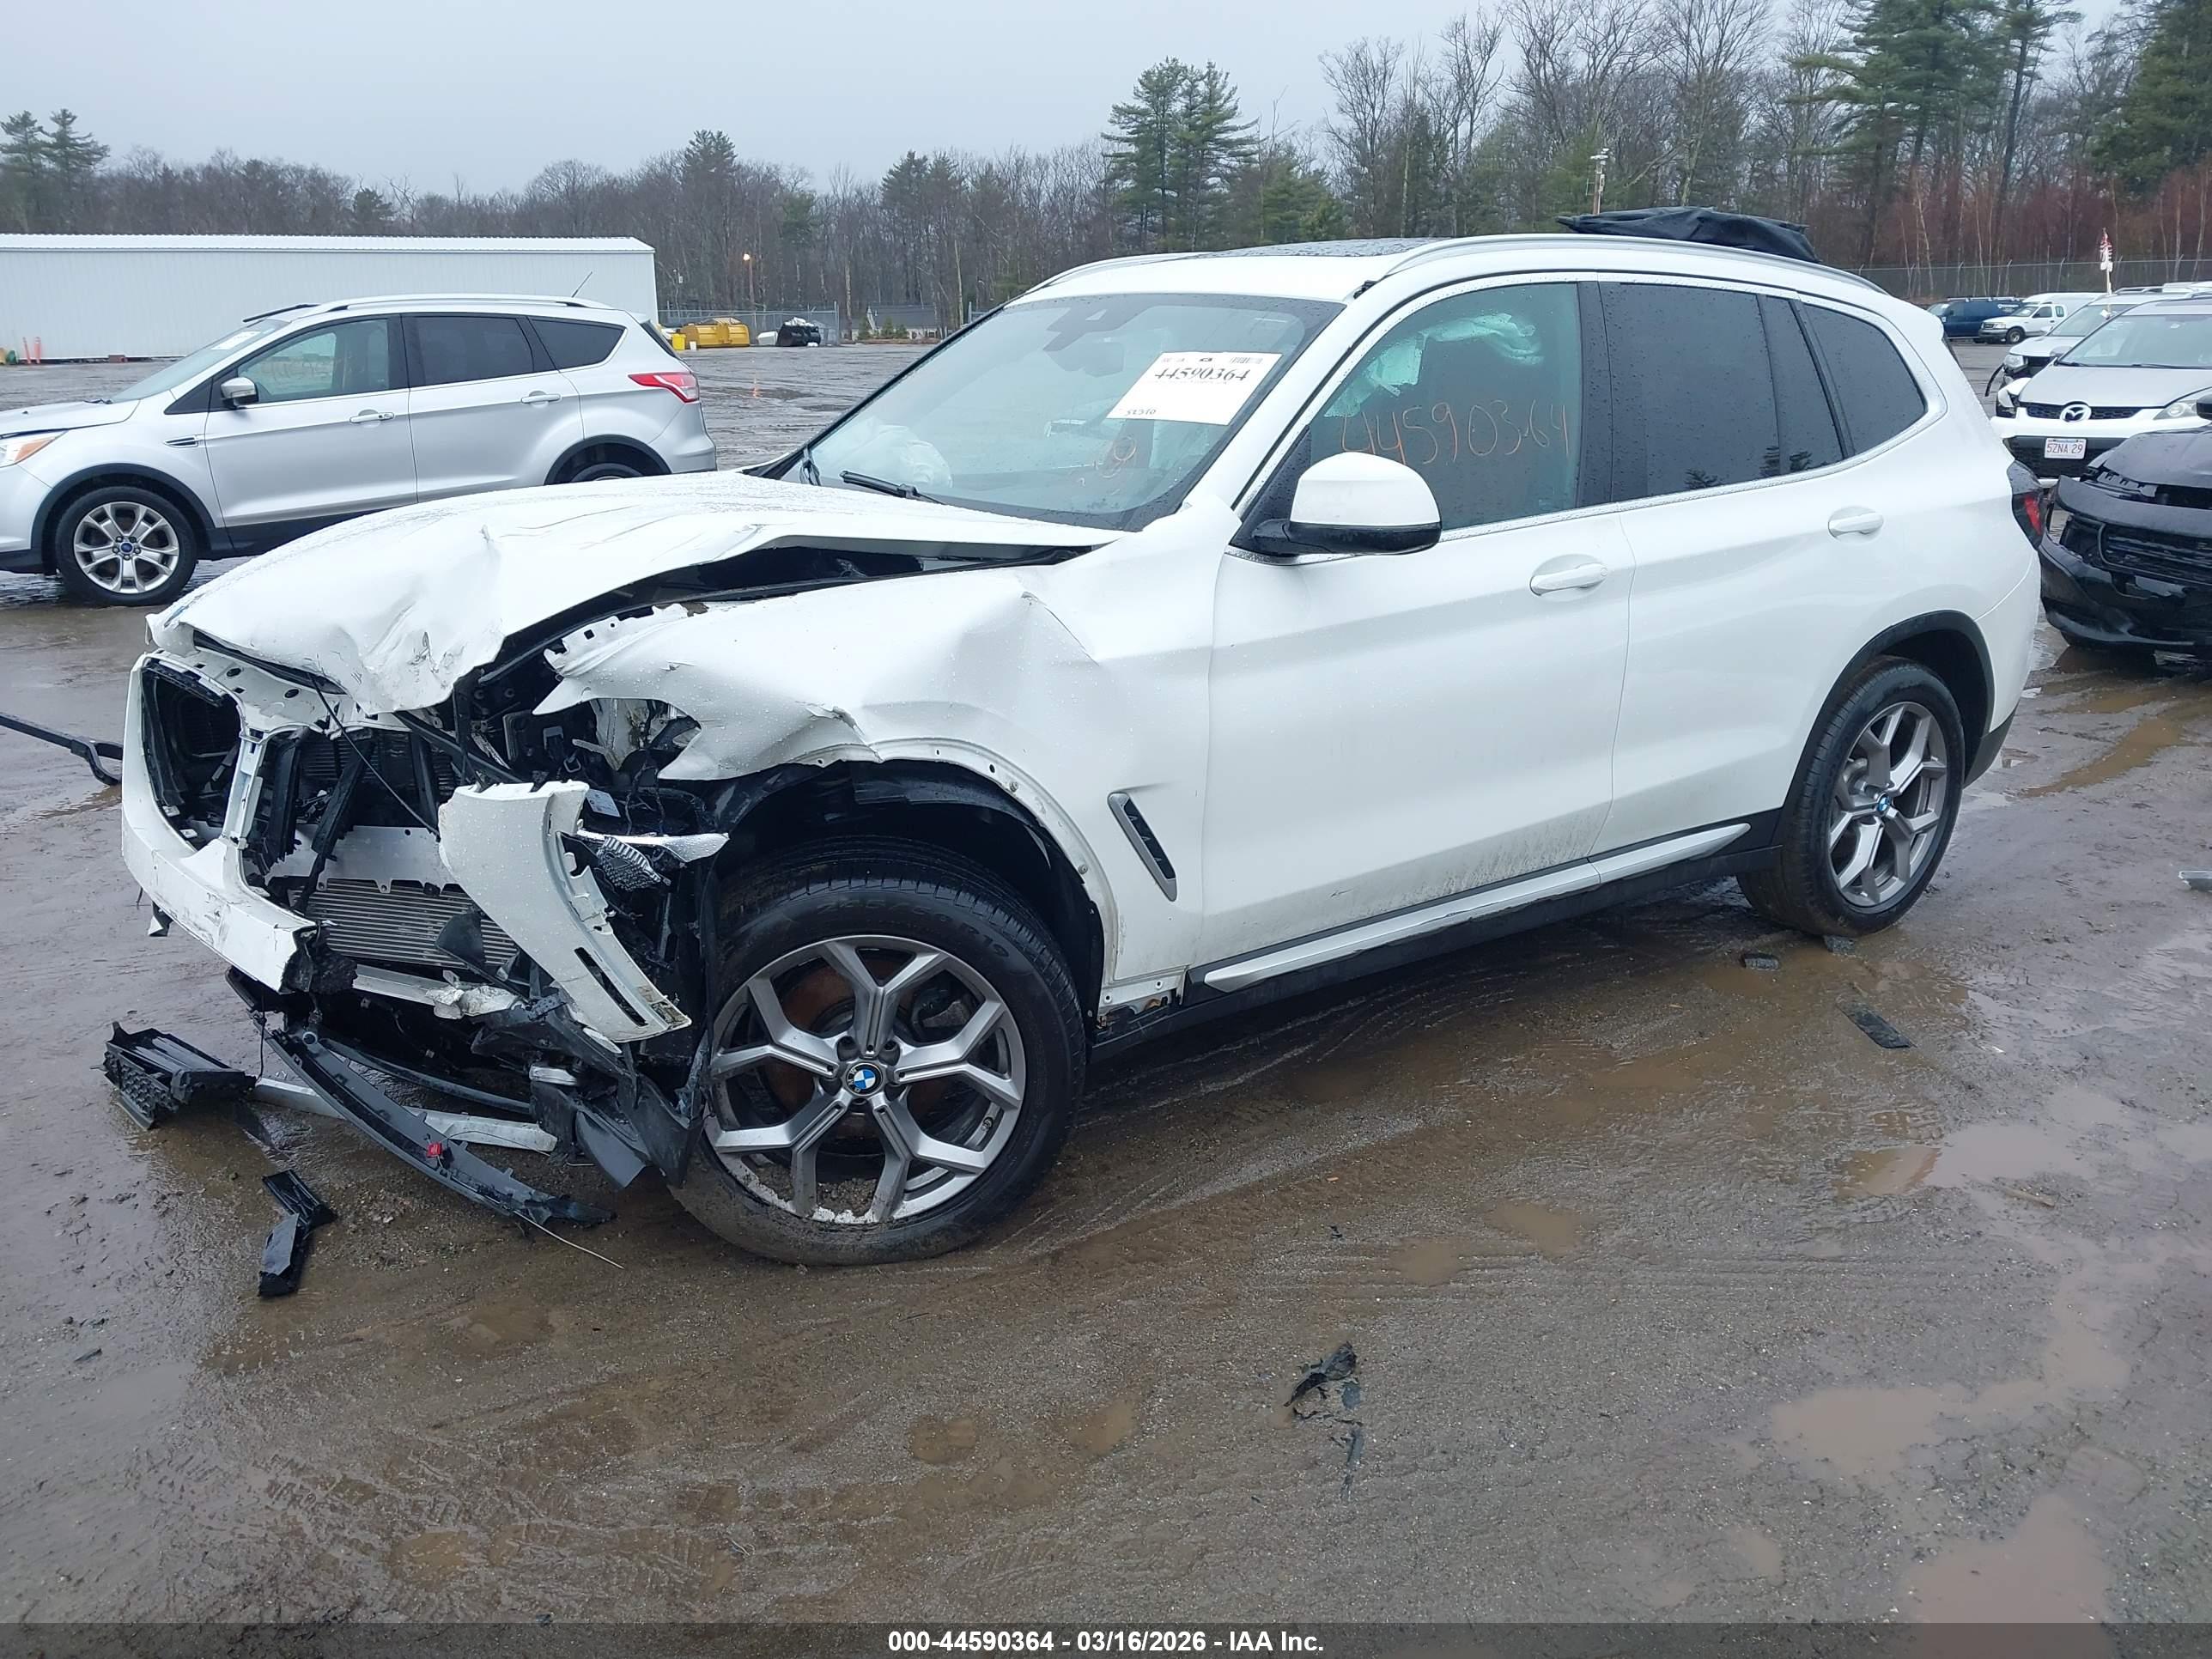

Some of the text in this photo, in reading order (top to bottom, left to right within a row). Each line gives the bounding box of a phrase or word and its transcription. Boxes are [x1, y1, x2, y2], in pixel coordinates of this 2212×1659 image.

[1155, 367, 1251, 381] 44590364
[1341, 399, 1570, 465] 44590364
[2046, 443, 2083, 453] 5ZNA 29
